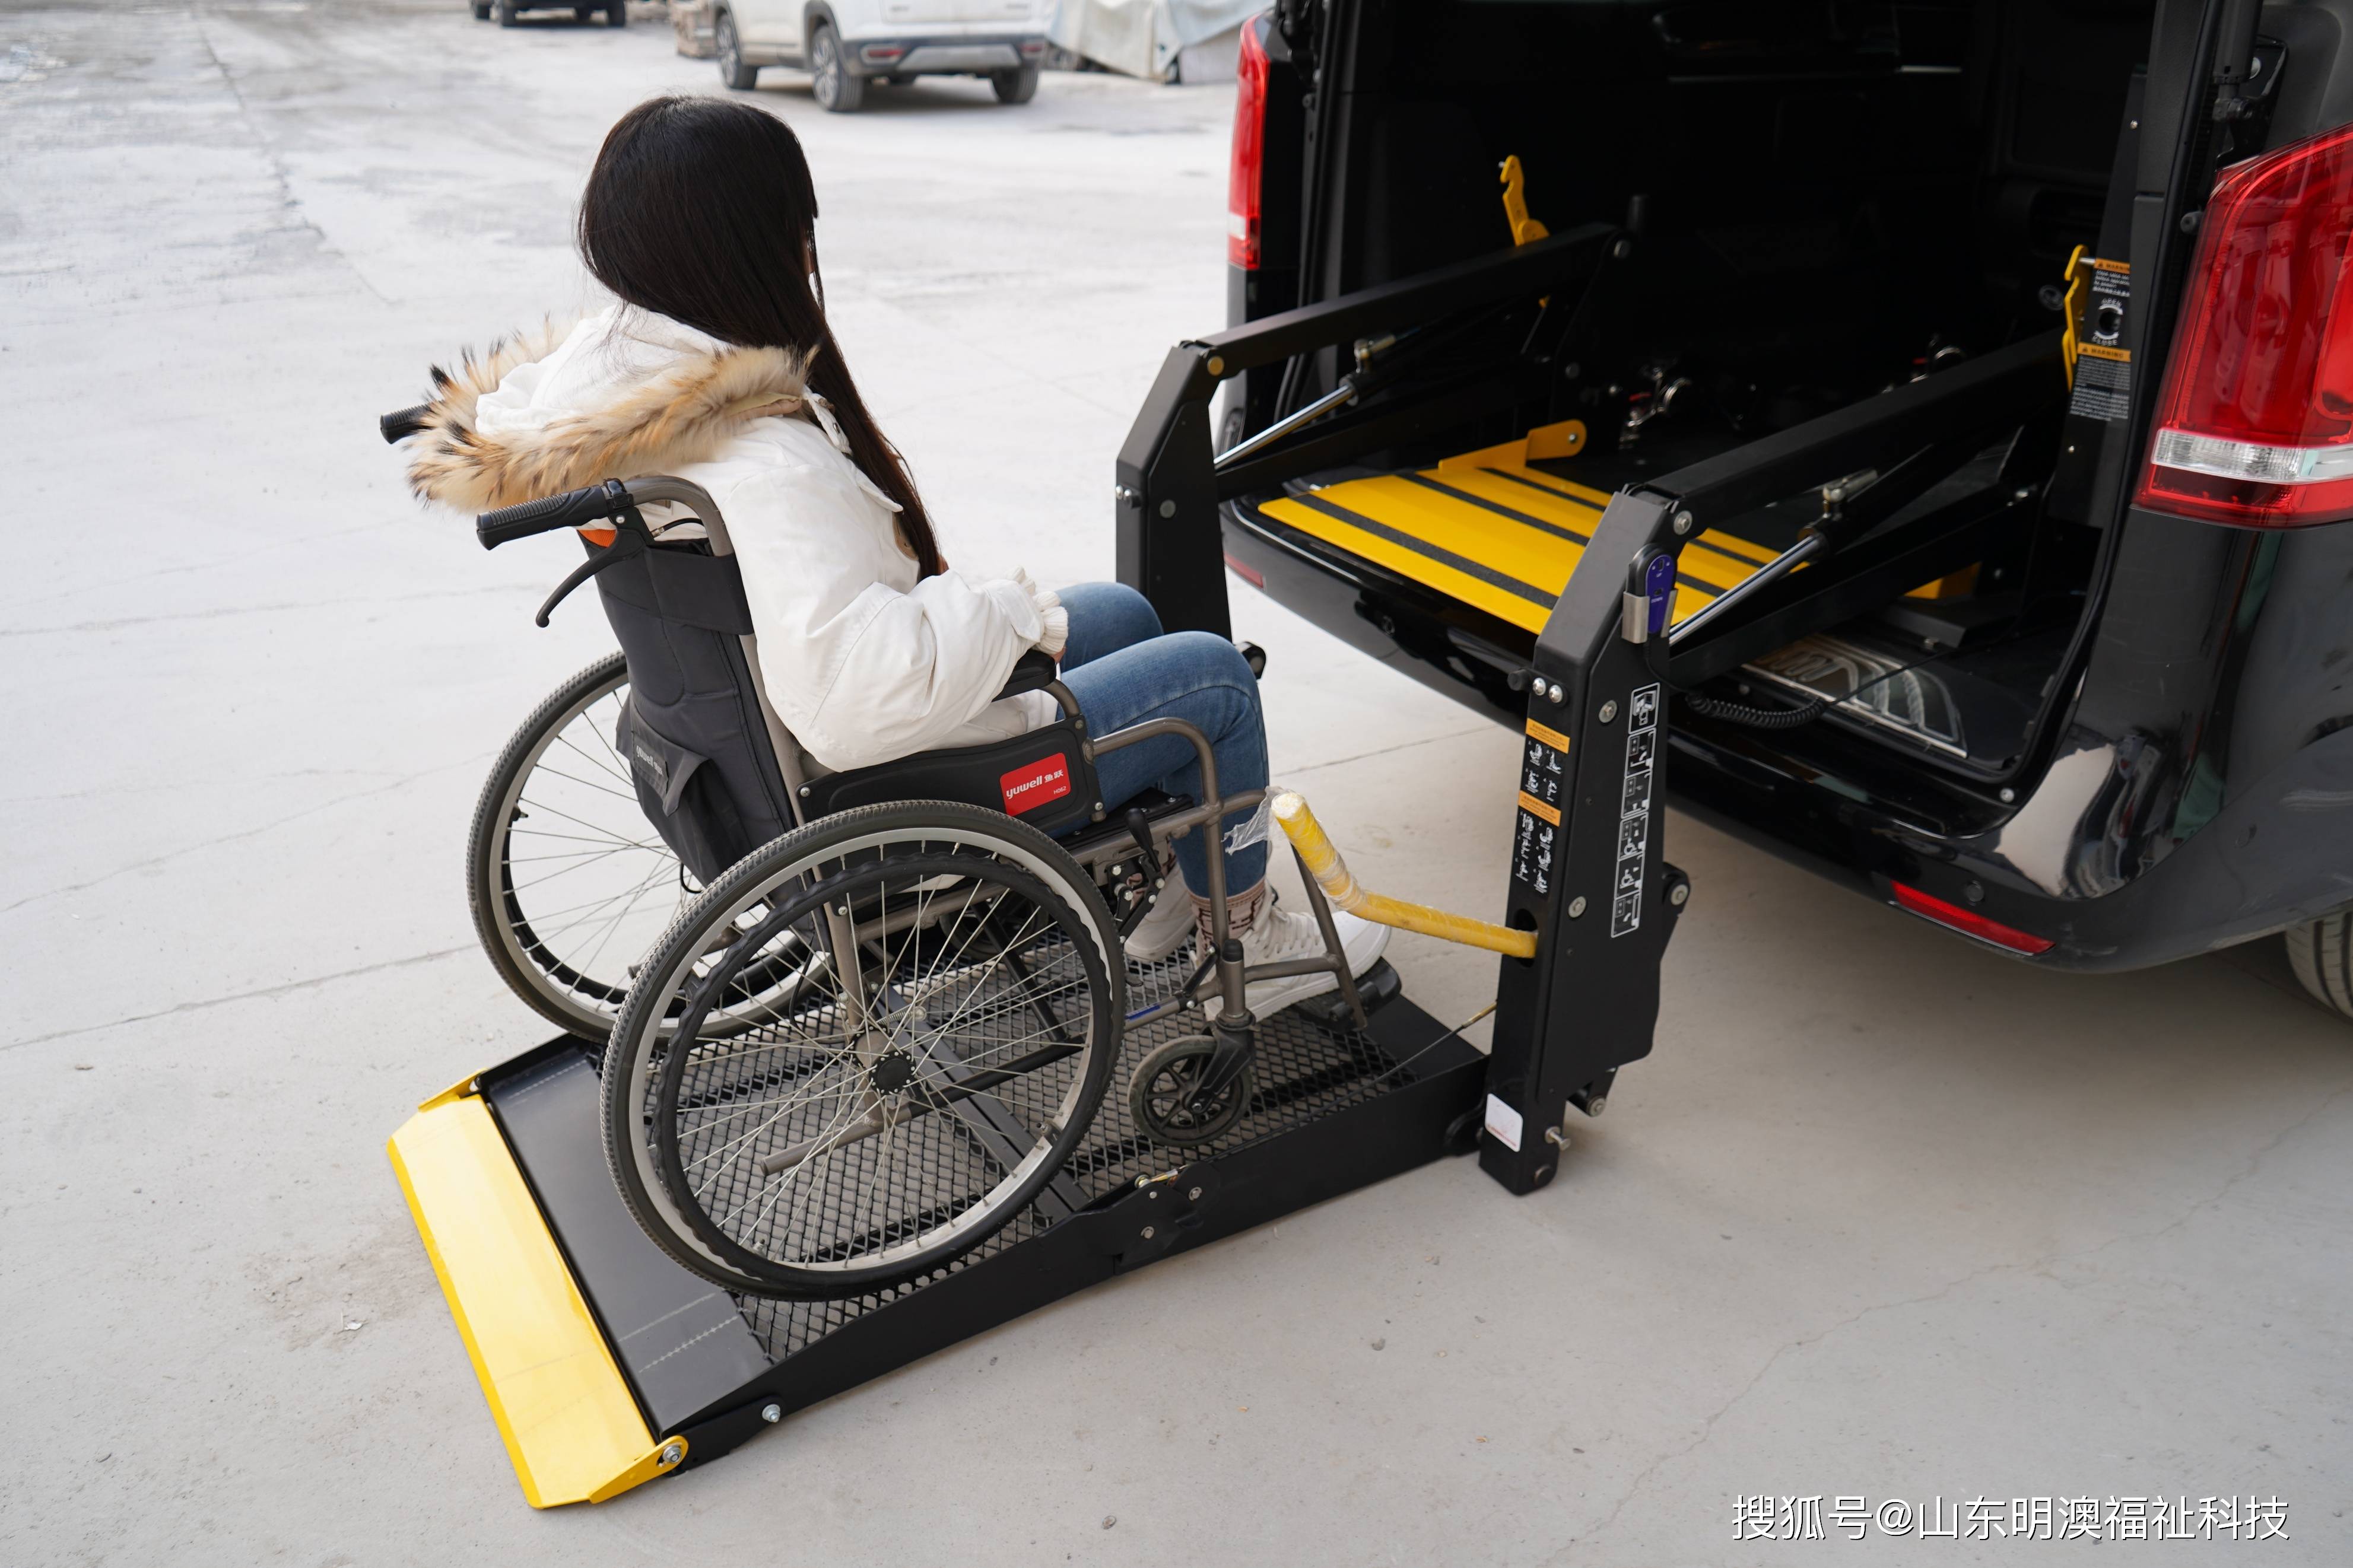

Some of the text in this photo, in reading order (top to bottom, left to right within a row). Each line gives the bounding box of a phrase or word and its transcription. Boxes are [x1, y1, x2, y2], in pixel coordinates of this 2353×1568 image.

[2101, 298, 2123, 307] OPEN
[2092, 335, 2118, 346] CLOSE
[2091, 348, 2125, 358] WARNING
[1006, 769, 1064, 800] yuwell 鱼跃
